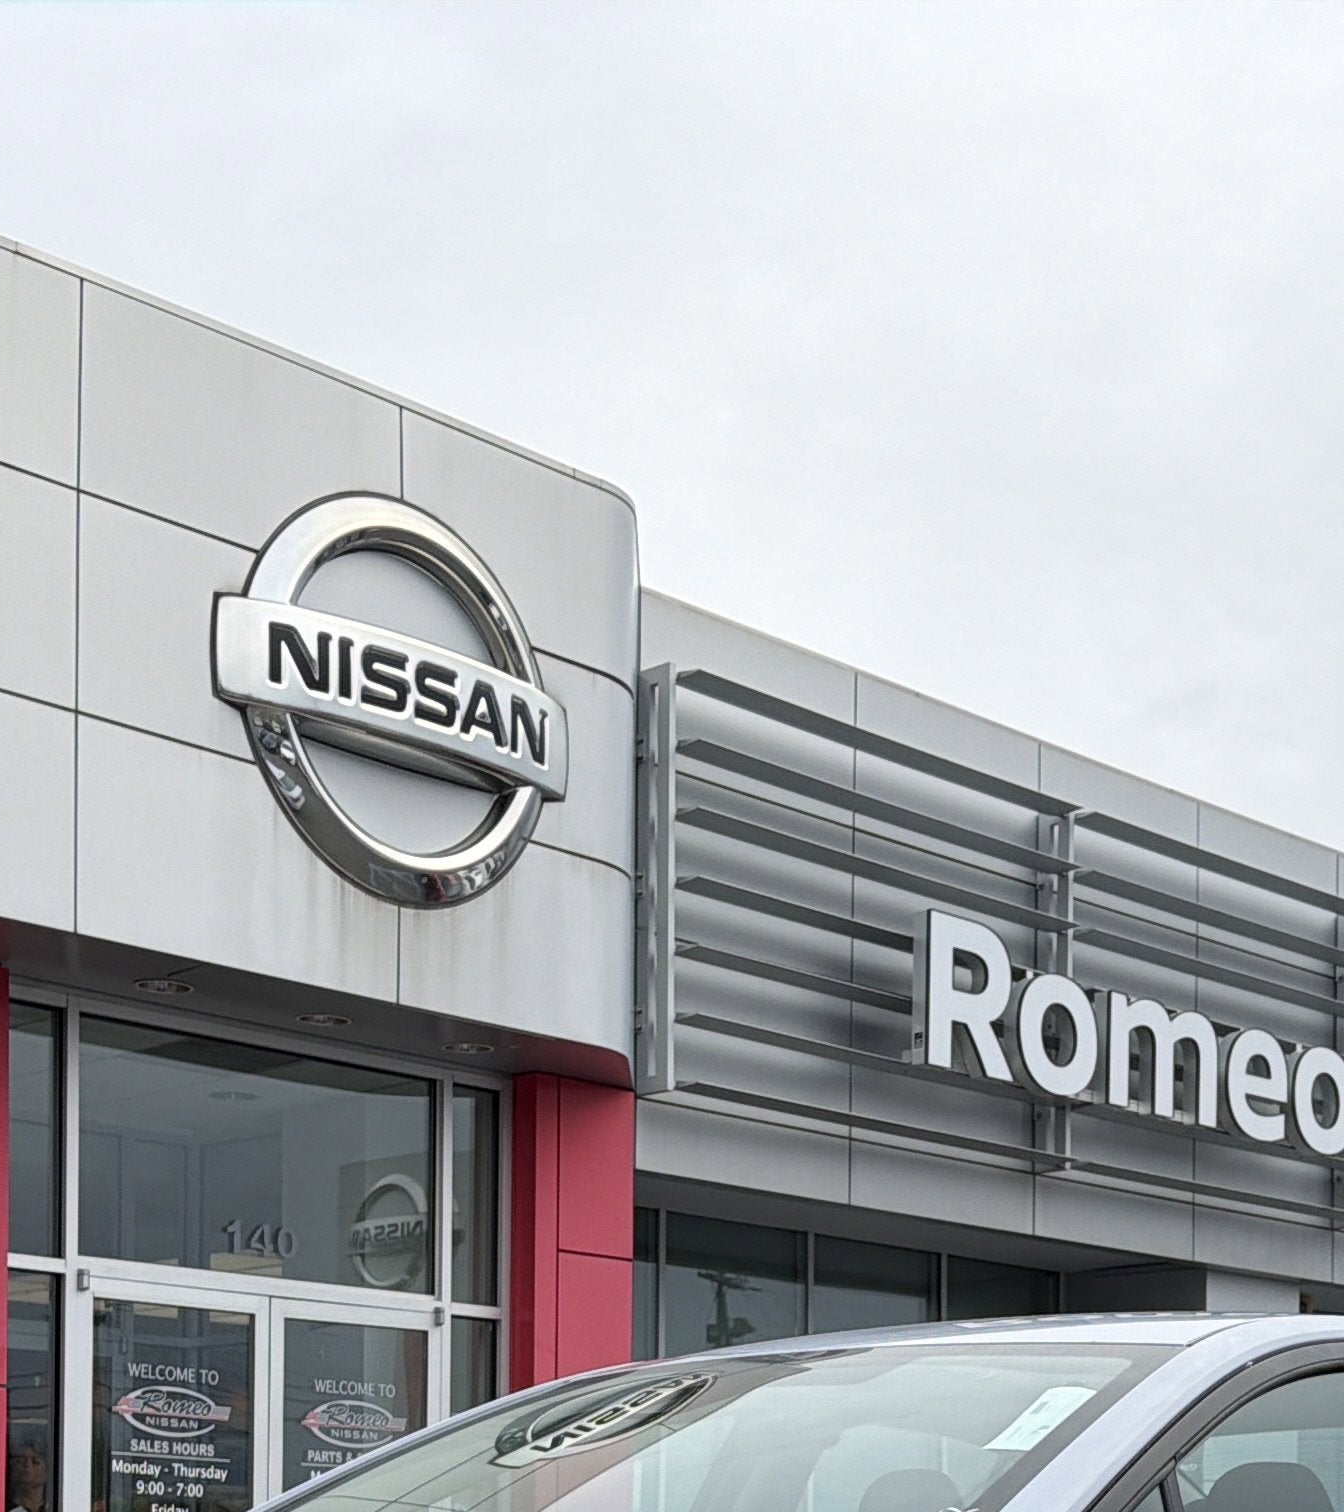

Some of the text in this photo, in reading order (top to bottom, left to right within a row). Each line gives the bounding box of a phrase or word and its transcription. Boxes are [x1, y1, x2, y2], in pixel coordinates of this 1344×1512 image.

[267, 621, 548, 768] NISSAN
[224, 1219, 297, 1259] 140
[128, 1362, 219, 1385] WELCOME TO
[314, 1379, 396, 1398] WELCOME TO
[135, 1389, 212, 1416] Romeo
[145, 1416, 199, 1430] NISSAN
[321, 1403, 390, 1427] Romeo
[330, 1429, 378, 1441] NISSAN
[130, 1439, 215, 1457] SALES HOURS
[307, 1450, 343, 1463] PARTS
[112, 1459, 161, 1478] Monday
[171, 1463, 228, 1482] Thursday
[136, 1480, 164, 1495] 9:00
[176, 1483, 204, 1498] 7:00
